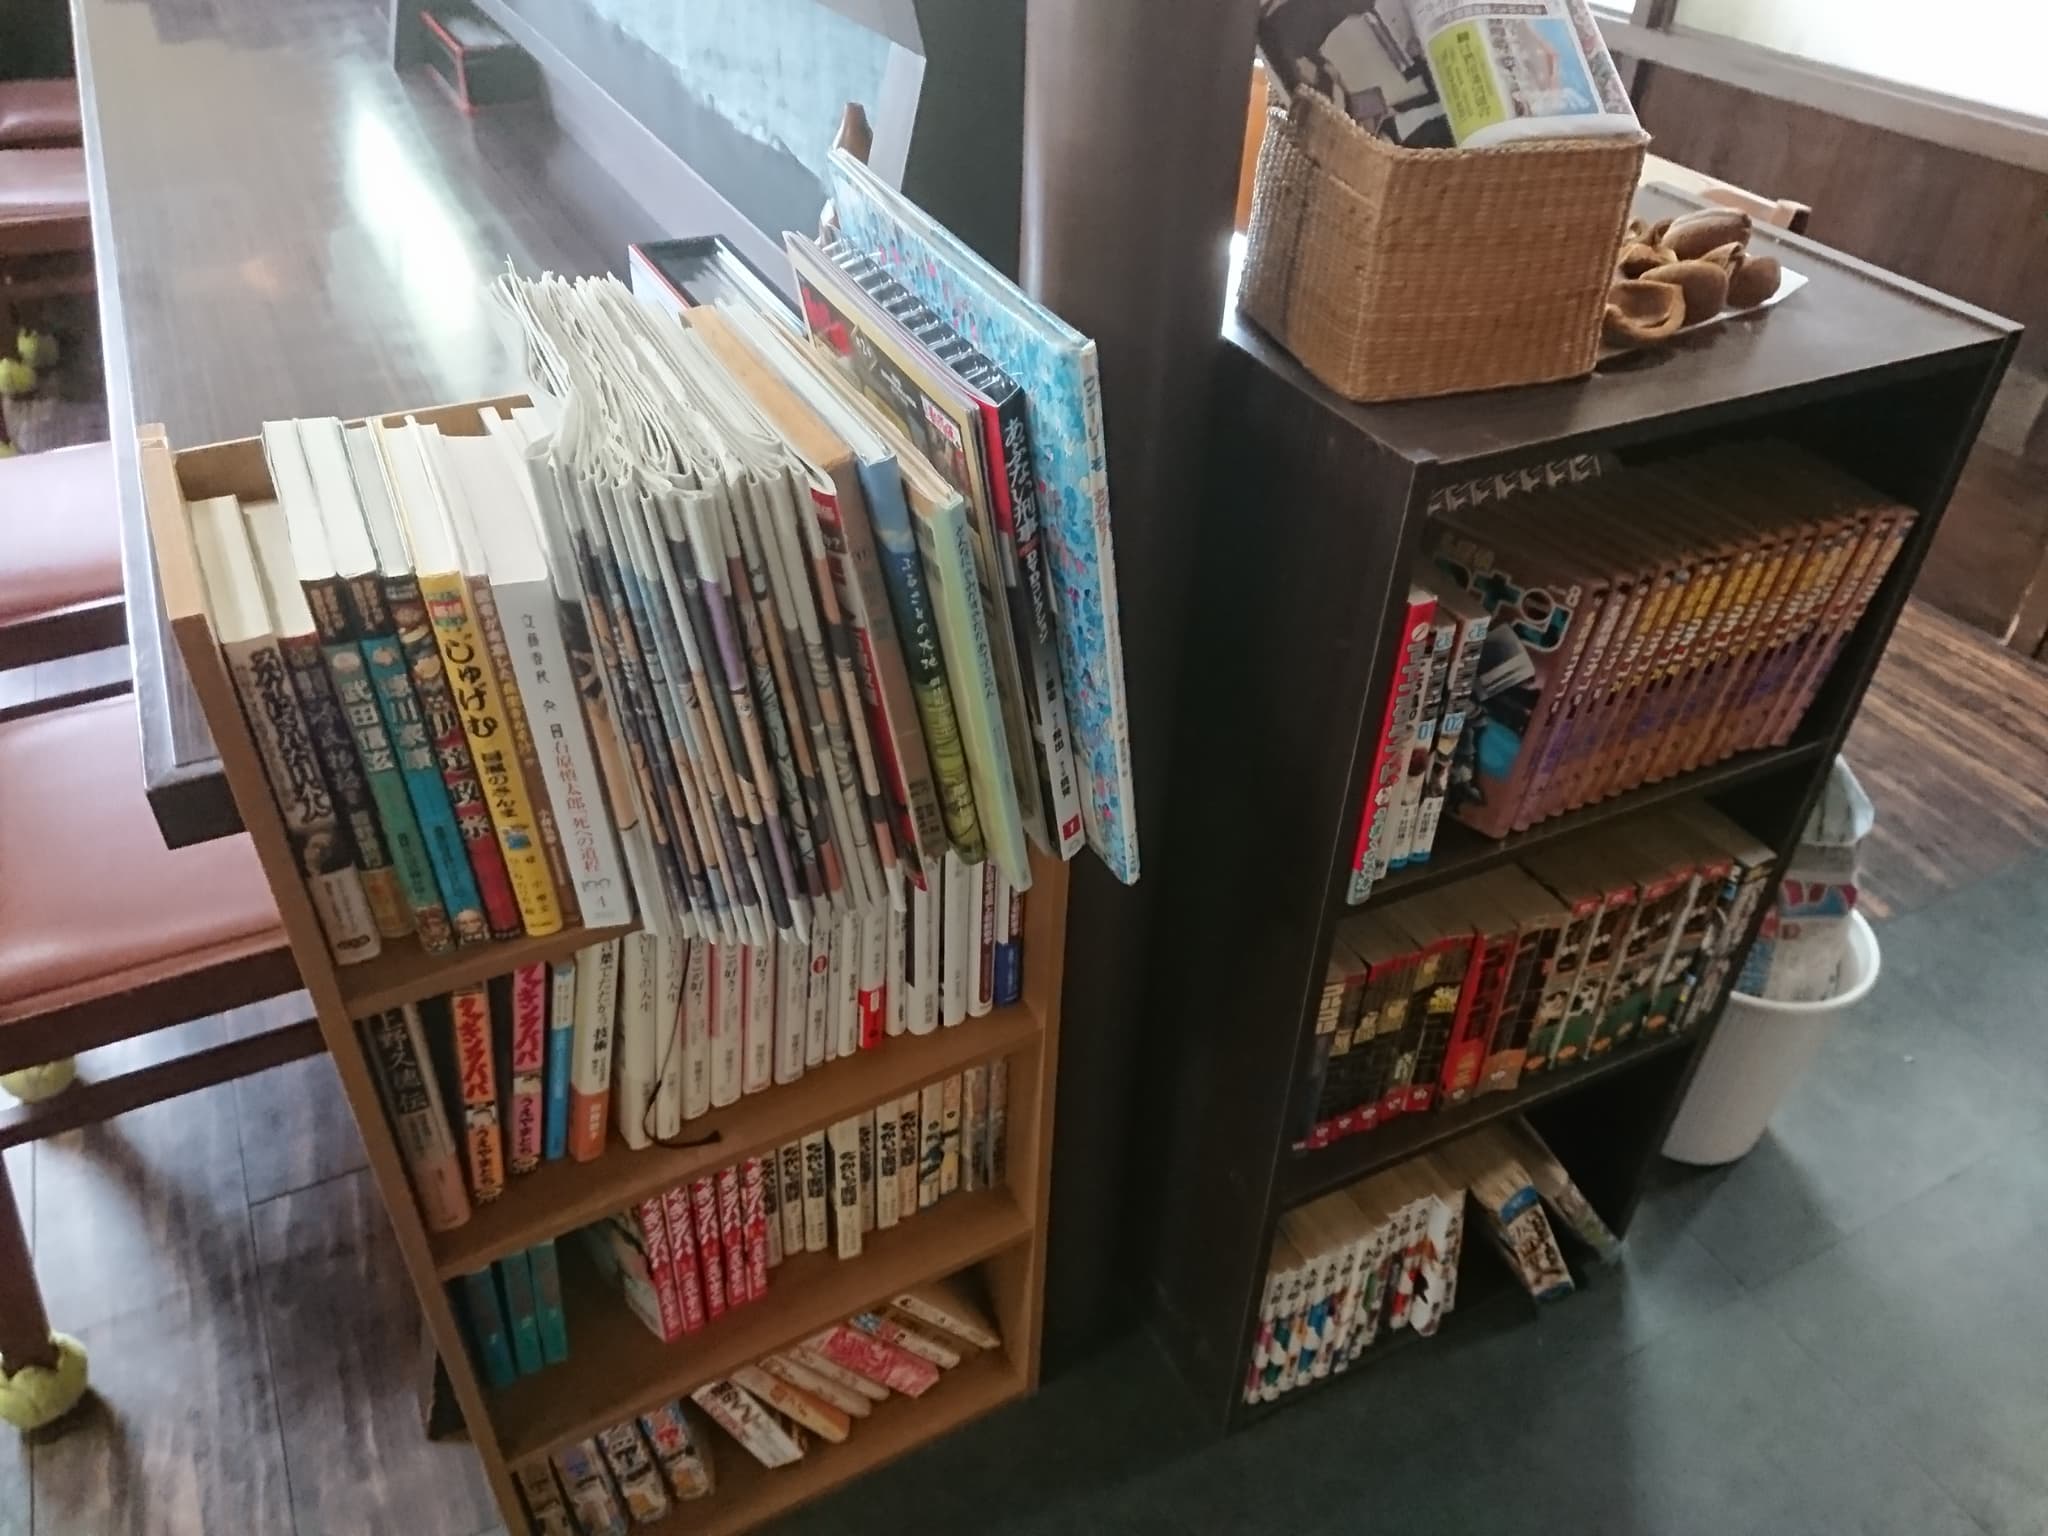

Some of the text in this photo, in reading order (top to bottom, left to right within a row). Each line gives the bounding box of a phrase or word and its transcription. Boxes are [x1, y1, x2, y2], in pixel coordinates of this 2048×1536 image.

[341, 679, 394, 772] 武田信玄
[445, 634, 499, 739] じゅげむ
